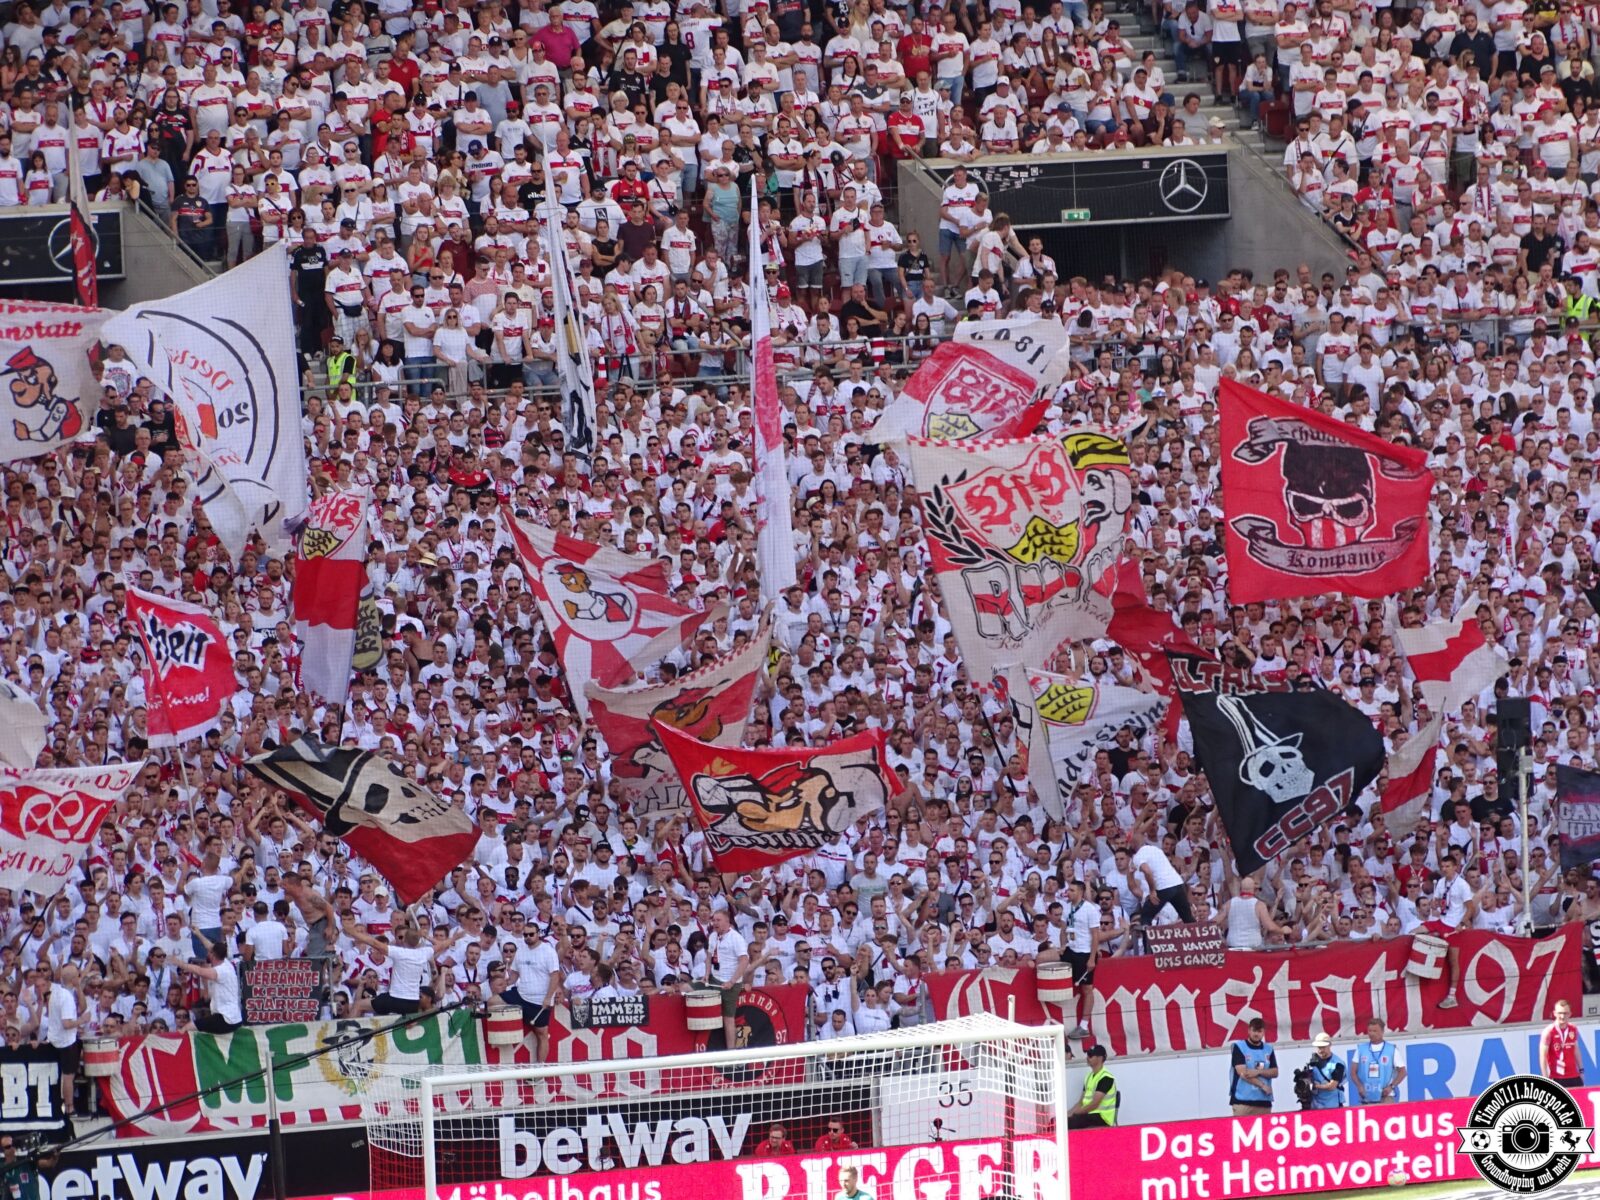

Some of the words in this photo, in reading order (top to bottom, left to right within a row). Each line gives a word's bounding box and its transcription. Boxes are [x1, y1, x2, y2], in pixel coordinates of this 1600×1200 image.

[1287, 549, 1387, 569] Kompanie
[1253, 766, 1355, 860] CC97
[1146, 927, 1191, 940] ULTRA
[1151, 943, 1178, 954] DER
[1182, 940, 1223, 952] KAMPF
[254, 960, 312, 972] JEDER
[1155, 956, 1182, 968] UMS
[1184, 953, 1226, 966] GANZE
[245, 971, 320, 986] VERBANNTE
[1464, 934, 1566, 1027] 97
[252, 987, 313, 998] KEHRT
[592, 1003, 645, 1016] IMMER
[592, 1015, 612, 1025] BEI
[617, 1014, 646, 1024] UNS!
[197, 1022, 313, 1109] MF
[392, 1006, 483, 1089] 91
[937, 1079, 974, 1109] 35
[1141, 1127, 1215, 1161] Das
[1232, 1108, 1456, 1153] Möbelhaus
[500, 1112, 752, 1179] betway
[38, 1152, 268, 1200] etway
[1142, 1164, 1210, 1199] mit
[1223, 1142, 1456, 1192] Heimvorteil
